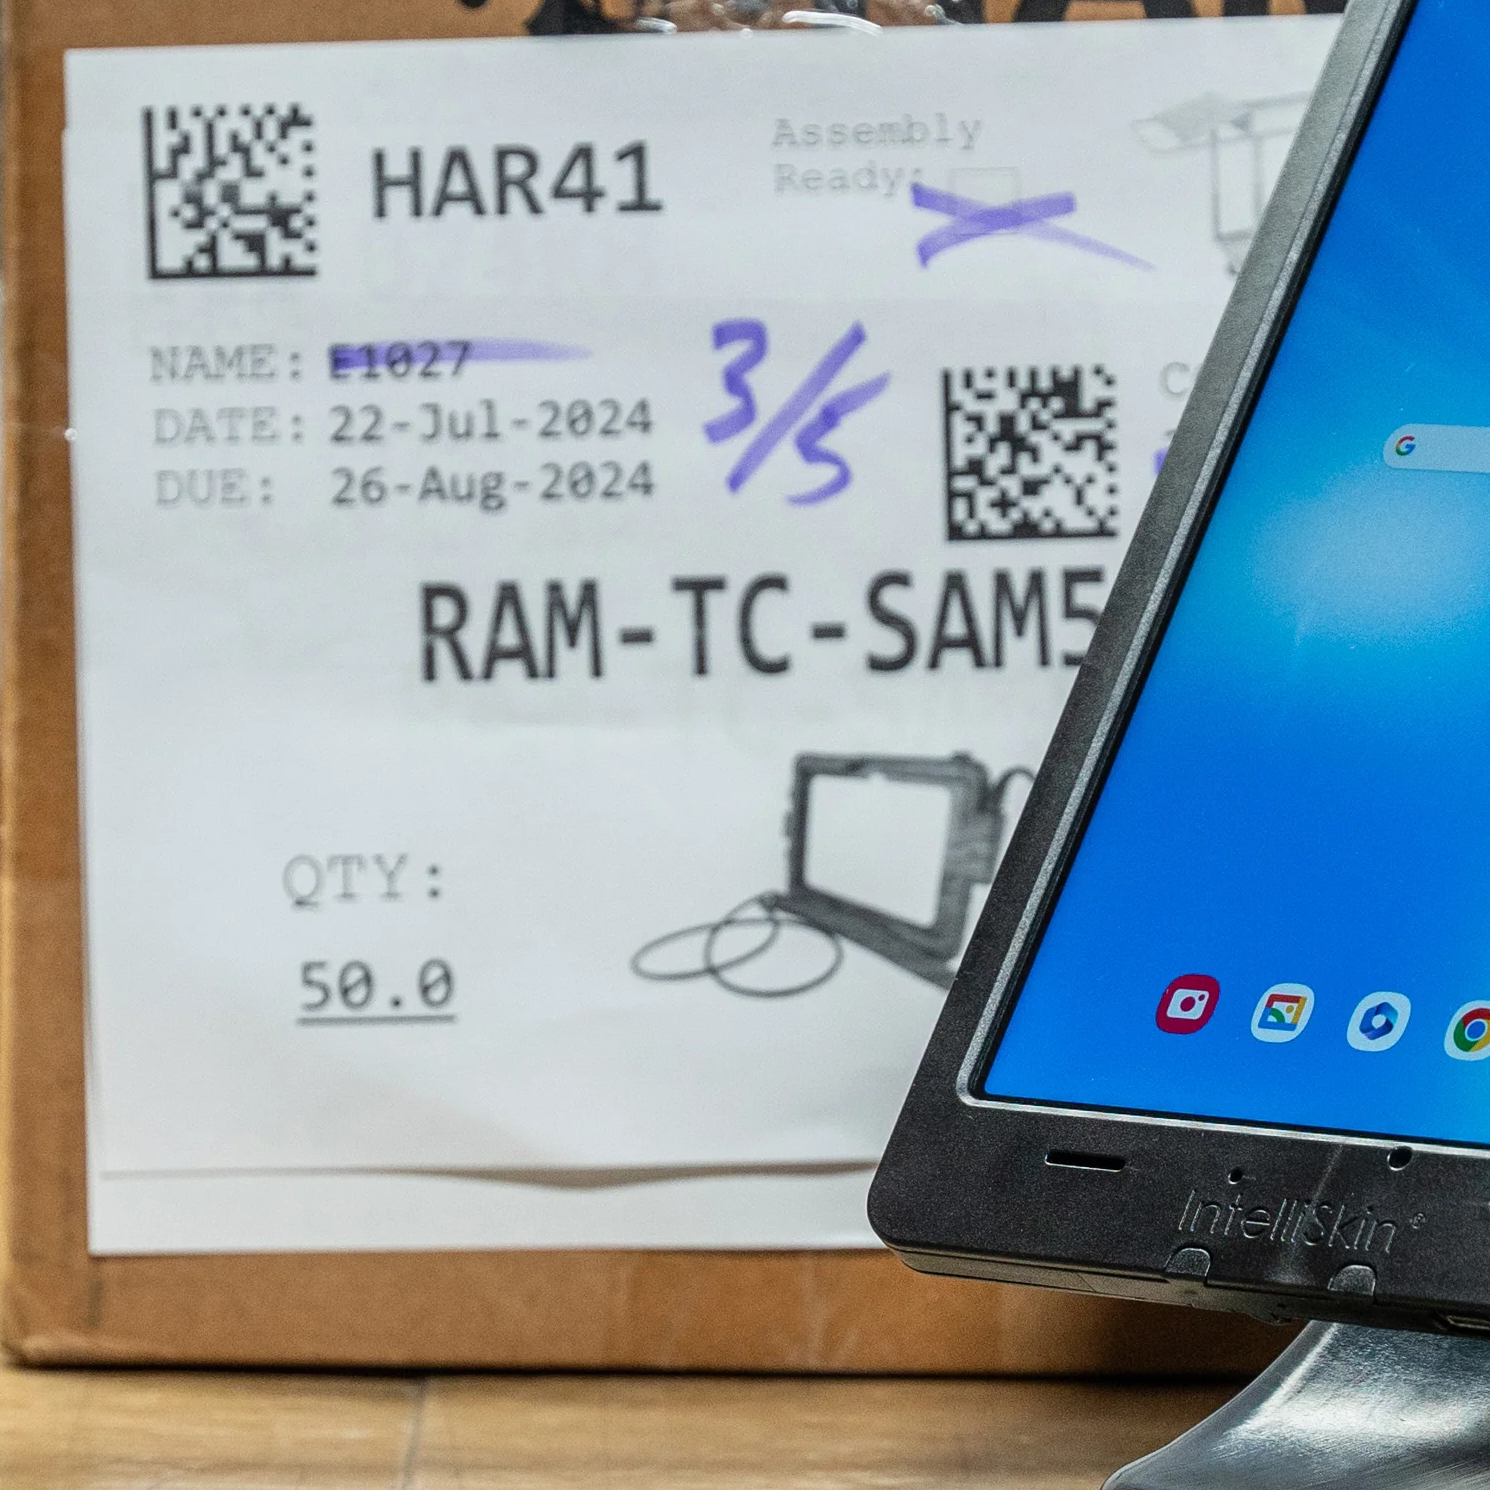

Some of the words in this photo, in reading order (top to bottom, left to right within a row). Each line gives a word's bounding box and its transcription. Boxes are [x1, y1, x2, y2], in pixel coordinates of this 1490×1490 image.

[771, 113, 982, 151] Assembly
[370, 139, 665, 220] HAR41
[149, 344, 302, 381] NAME:
[328, 340, 474, 381] E1027
[154, 407, 304, 446] DATE:
[329, 398, 654, 444] 22-Jul-2024
[701, 317, 891, 506] 3/5
[156, 467, 274, 506] DUE:
[330, 459, 655, 512] 26-Aug-2024
[419, 566, 1107, 682] RAM-TC-SAM5
[283, 853, 445, 909] QTY:
[299, 958, 455, 1013] 50.0
